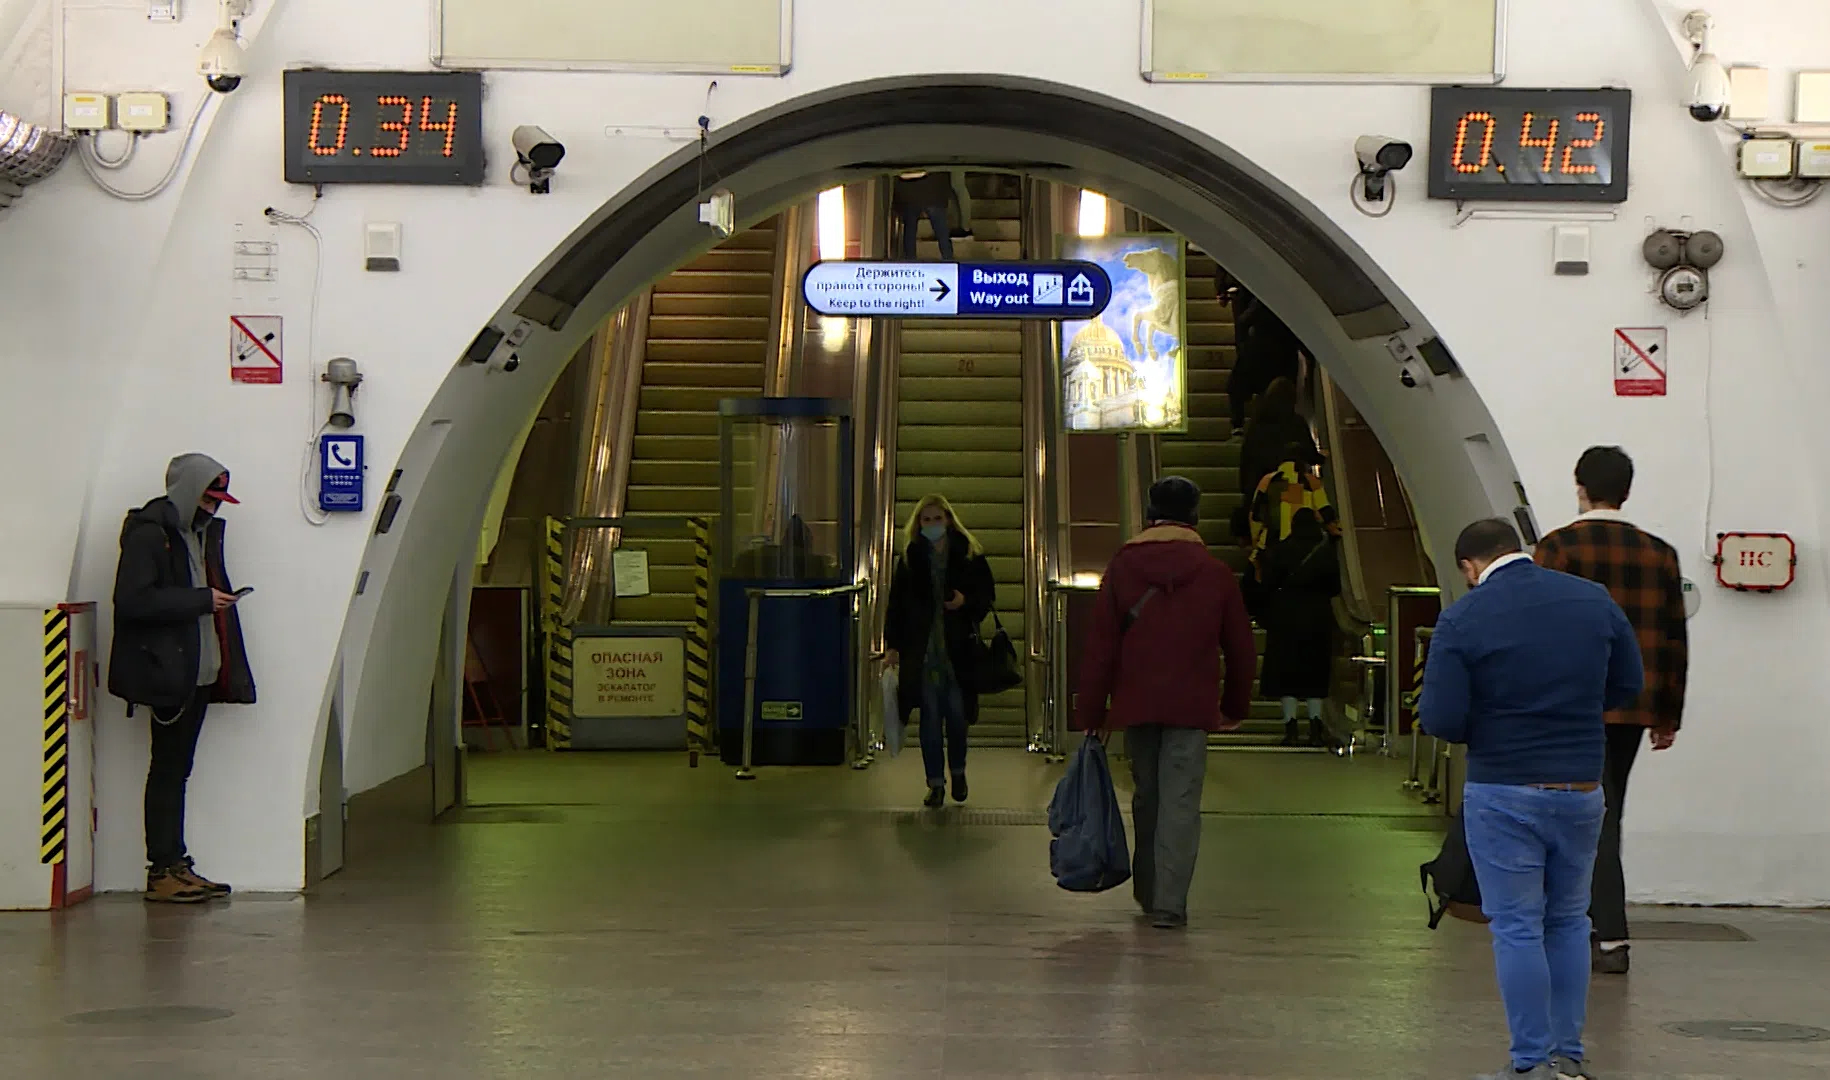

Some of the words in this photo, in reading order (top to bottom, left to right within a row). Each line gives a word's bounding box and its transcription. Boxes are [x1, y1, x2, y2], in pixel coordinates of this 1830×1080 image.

[308, 93, 457, 157] 0.34
[1451, 111, 1605, 174] 0.42
[855, 267, 925, 280] Держитесь
[972, 269, 1029, 287] Выход
[816, 281, 864, 293] правой
[867, 281, 925, 293] стороны!
[829, 298, 857, 309] Keep
[859, 298, 871, 308] to
[873, 298, 892, 308] the
[894, 298, 925, 309] right!
[970, 291, 1003, 308] Way
[1004, 293, 1030, 305] out
[591, 652, 663, 664] ОПАСНАЯ
[606, 667, 646, 679] ЗОНА
[597, 683, 656, 692] ЭСКАЛАТОР
[607, 695, 654, 703] РЕМОНТЕ
